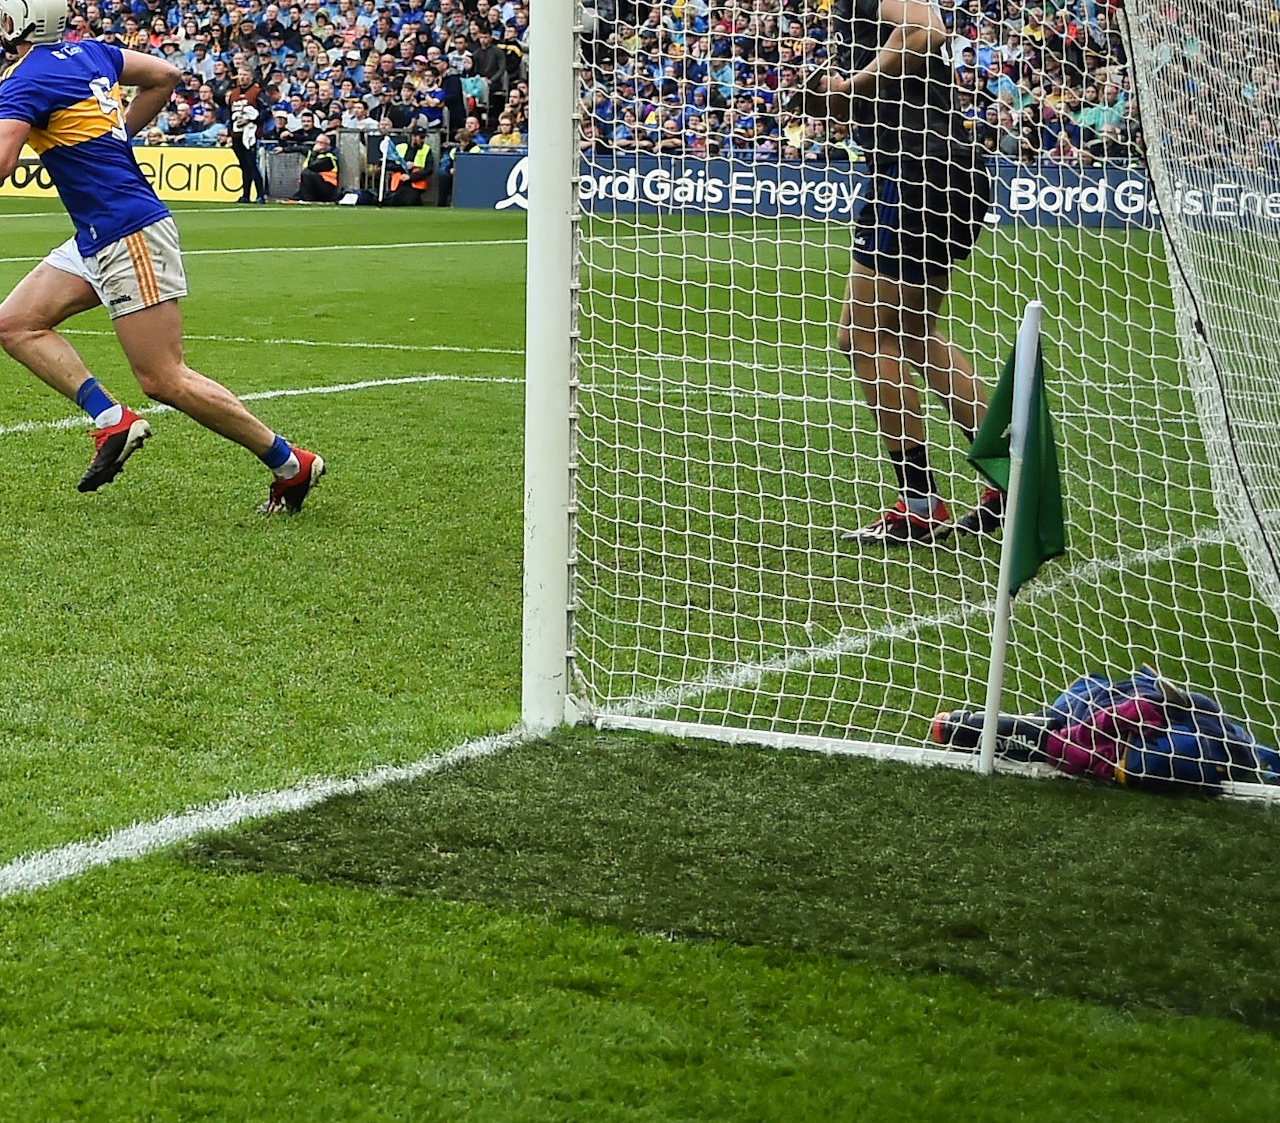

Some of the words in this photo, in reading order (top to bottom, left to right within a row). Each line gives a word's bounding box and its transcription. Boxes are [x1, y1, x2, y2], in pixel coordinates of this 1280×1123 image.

[643, 168, 722, 204] Gáis
[731, 173, 862, 214] Energy
[1009, 177, 1106, 213] Bord
